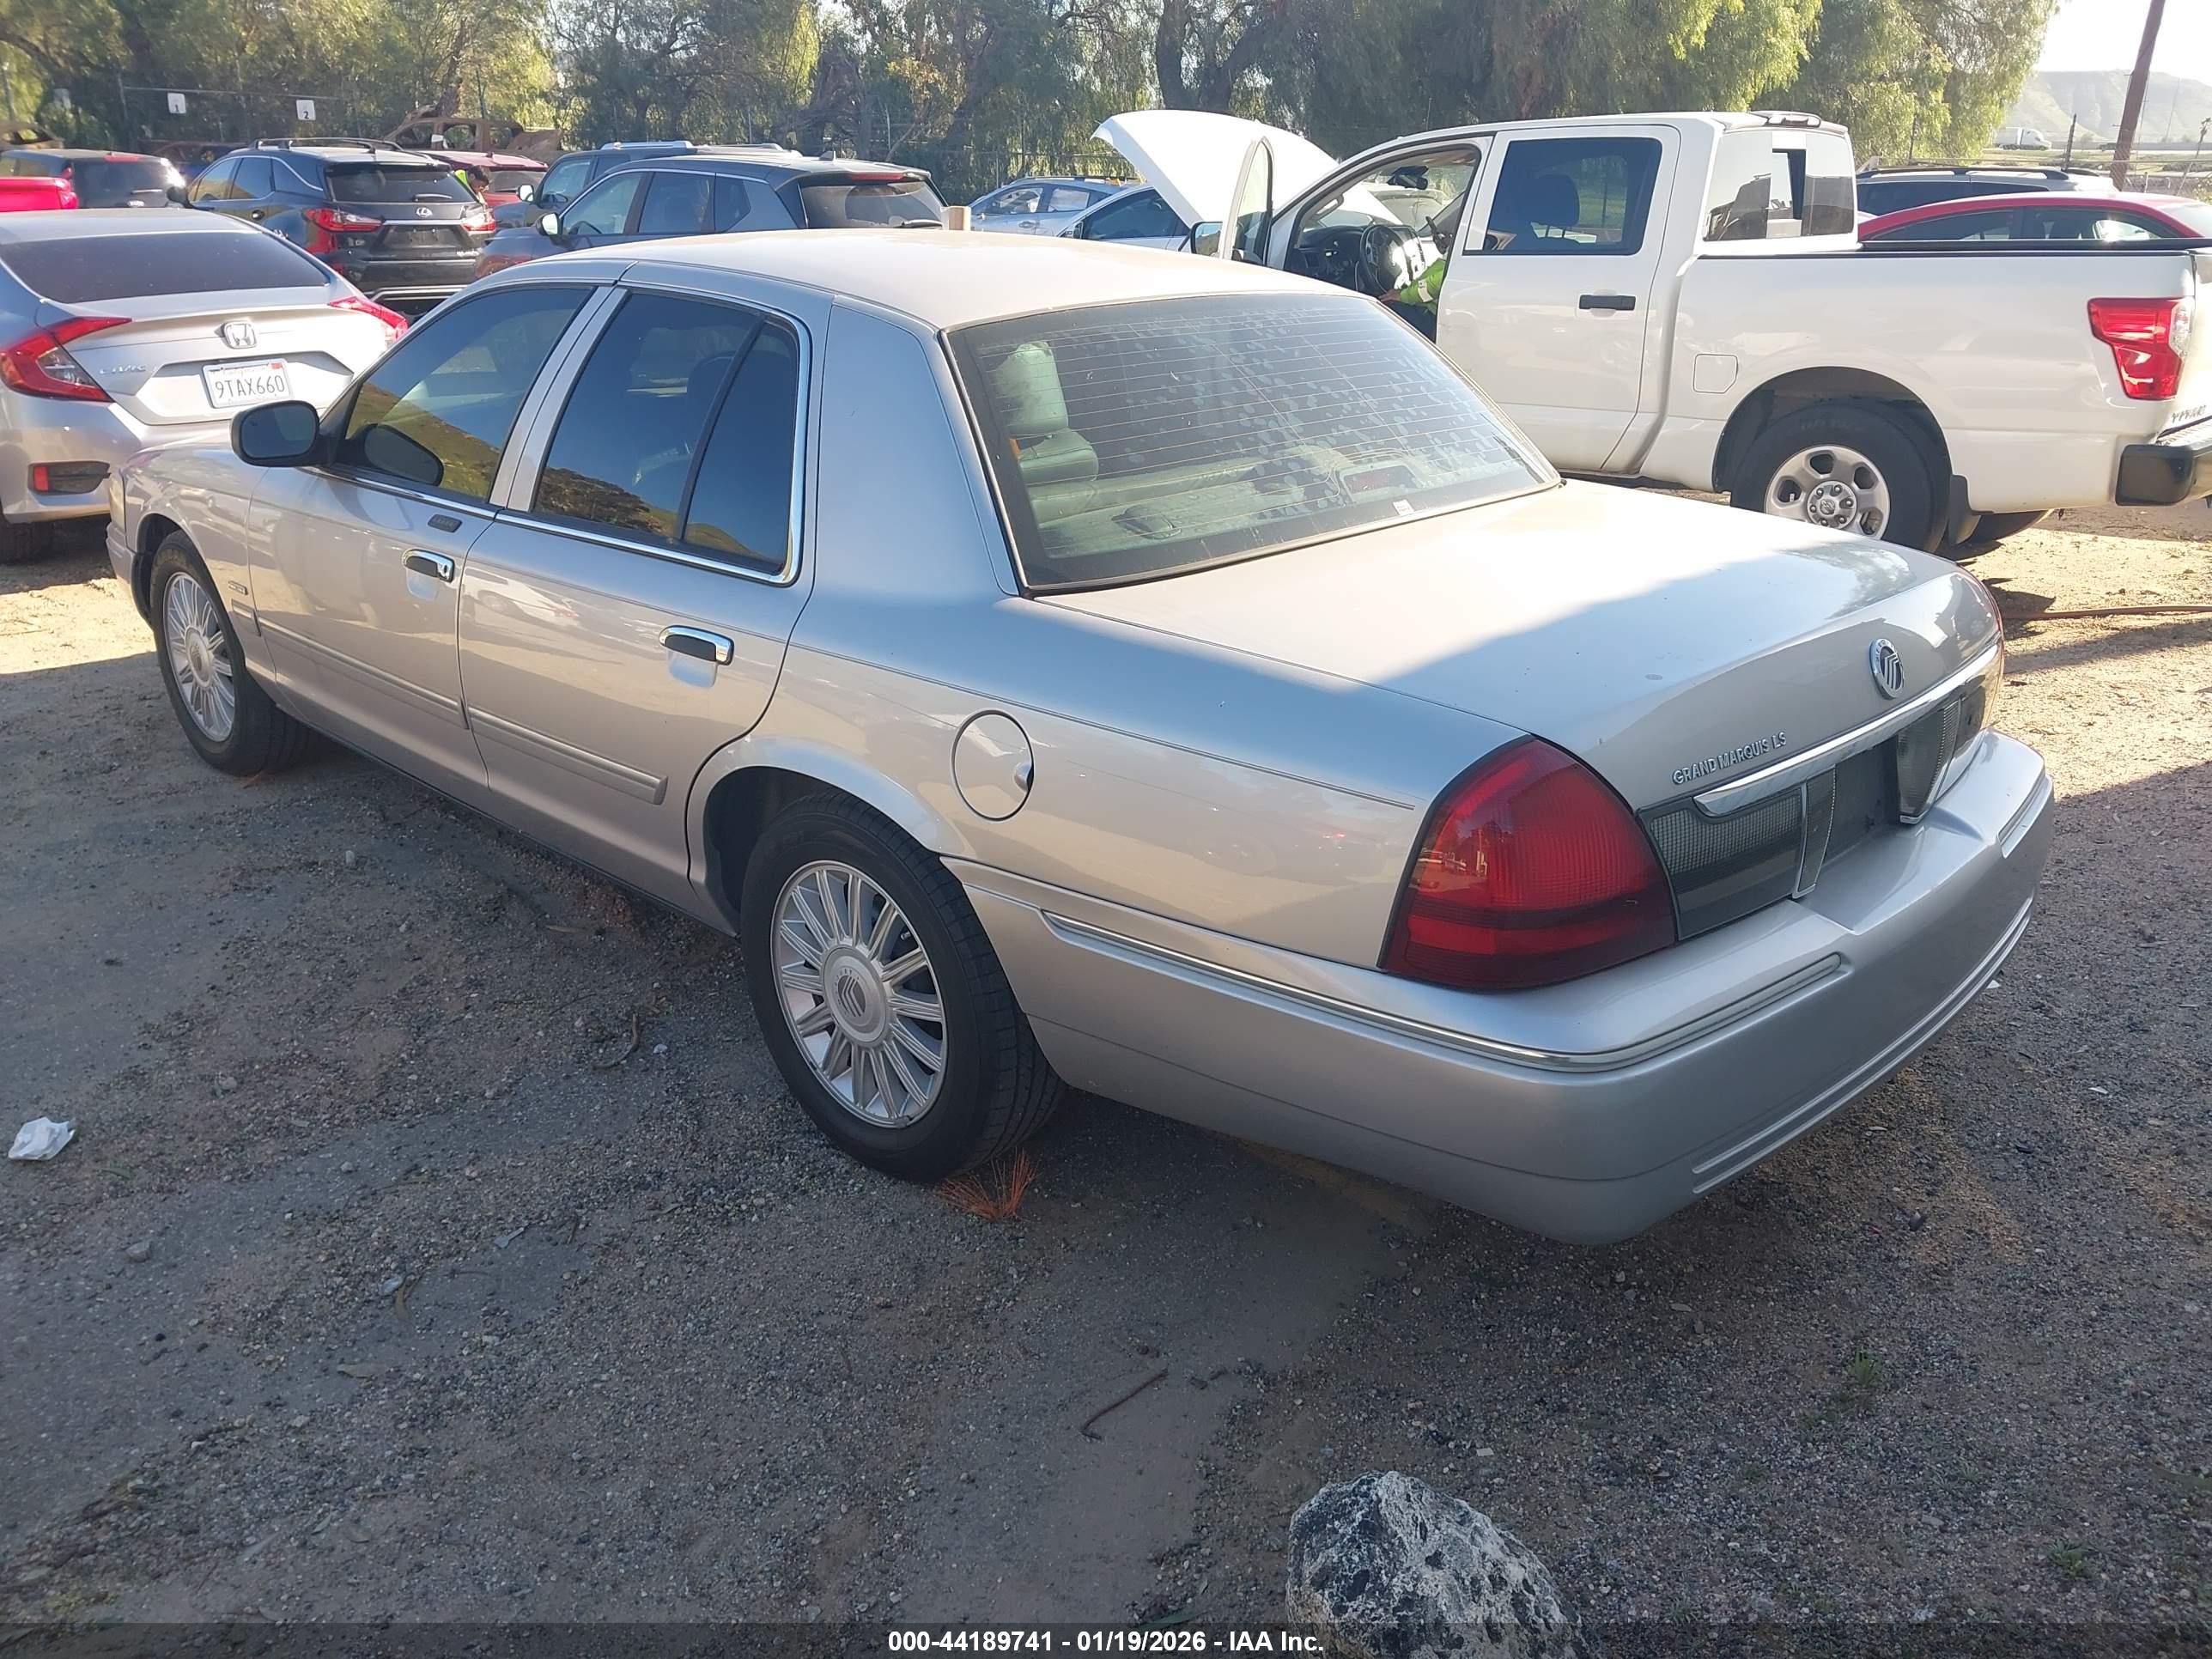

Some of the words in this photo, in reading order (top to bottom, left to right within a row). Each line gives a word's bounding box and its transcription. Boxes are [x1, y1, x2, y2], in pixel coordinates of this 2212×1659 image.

[303, 111, 310, 119] 2
[215, 374, 285, 398] 9TAX660
[1672, 757, 1717, 784] GRAND
[1717, 738, 1770, 769] MARQUIS
[1771, 732, 1787, 750] LS
